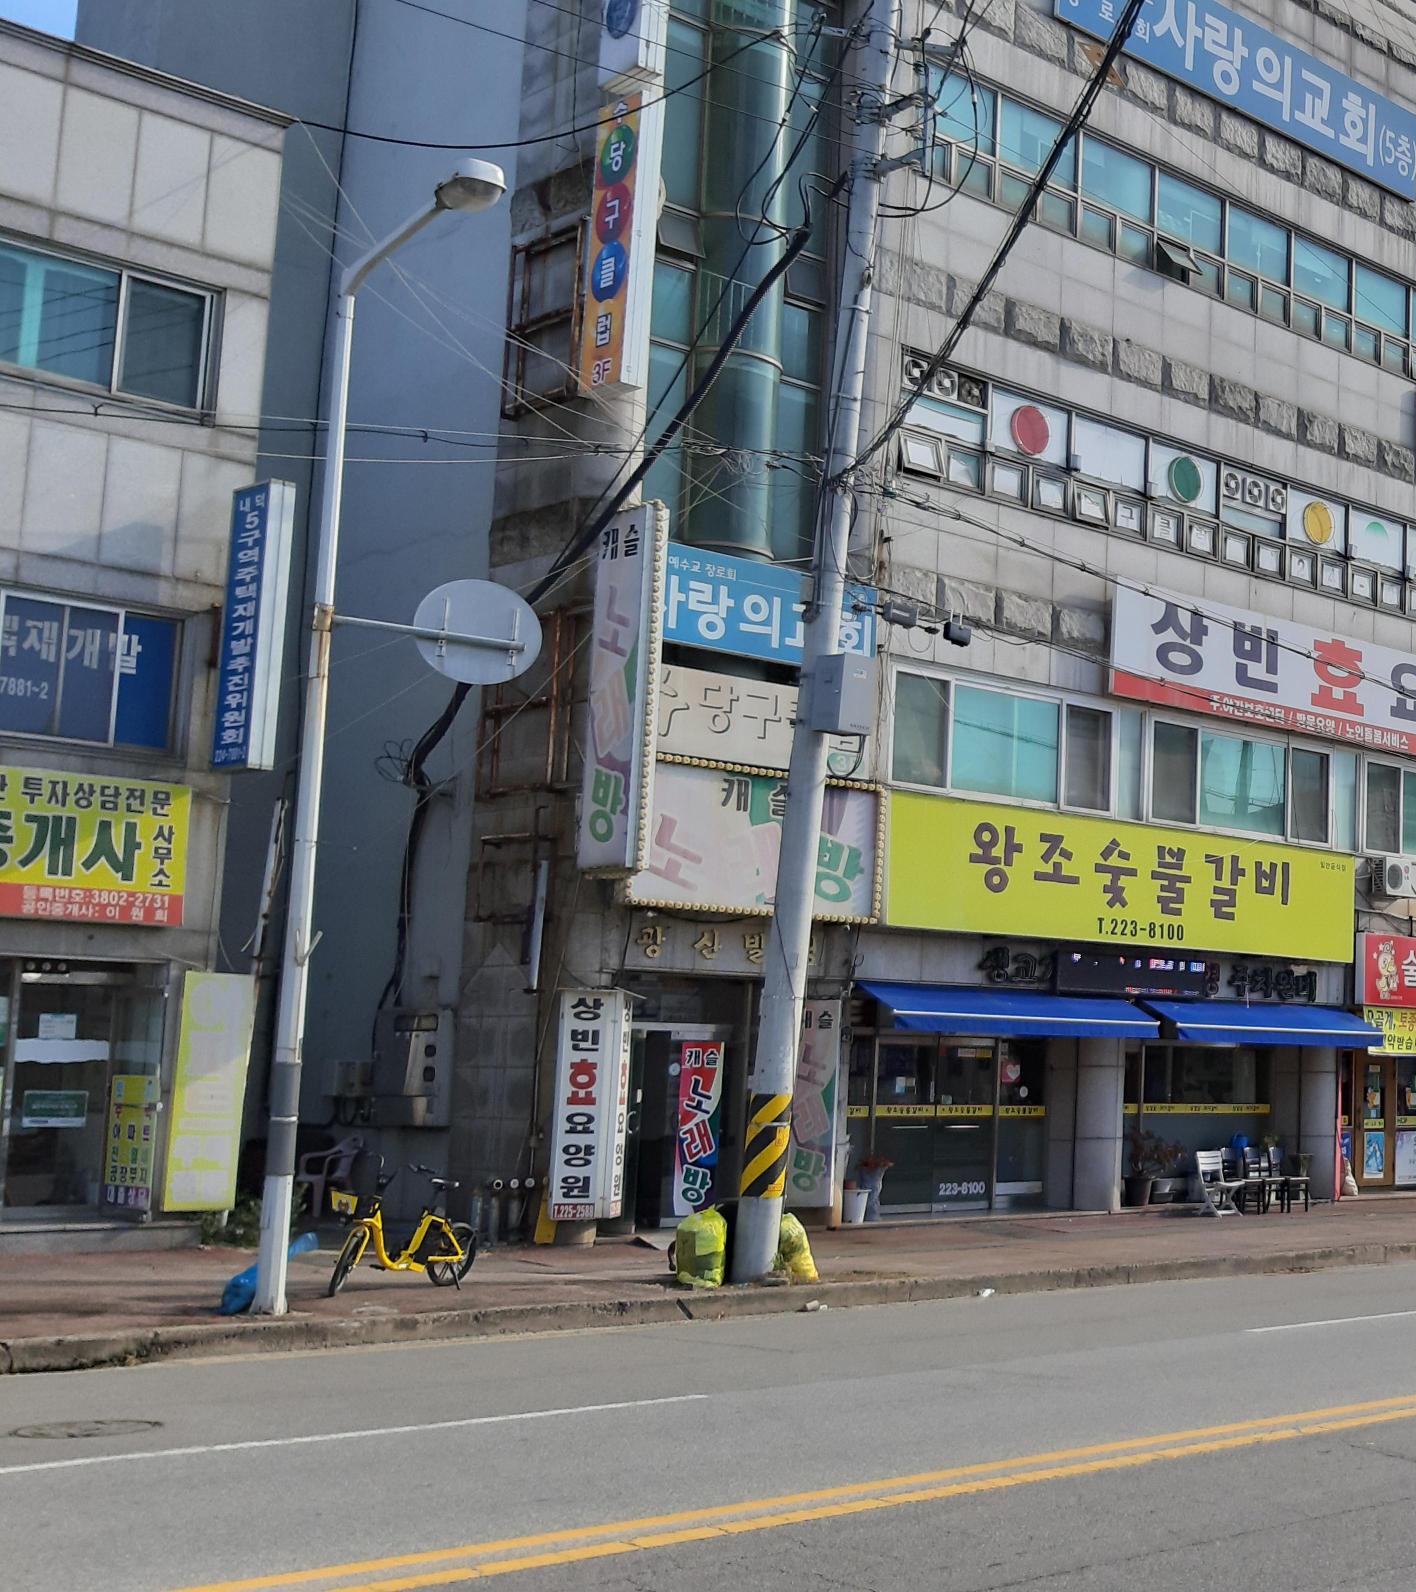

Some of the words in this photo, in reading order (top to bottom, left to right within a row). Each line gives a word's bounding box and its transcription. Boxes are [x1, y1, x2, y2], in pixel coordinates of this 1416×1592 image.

[592, 359, 612, 386] 3F
[601, 525, 640, 560] 캐슬
[150, 824, 175, 888] 사무소
[968, 821, 1291, 921] 왕조숯불갈비
[1097, 916, 1186, 941] T.223-8100
[686, 1048, 719, 1067] 캐슬
[560, 997, 603, 1199] 상빈효요양원
[680, 1076, 716, 1205] 노래방
[939, 1181, 986, 1196] 223-8100
[552, 1203, 594, 1219] T.225-2588
